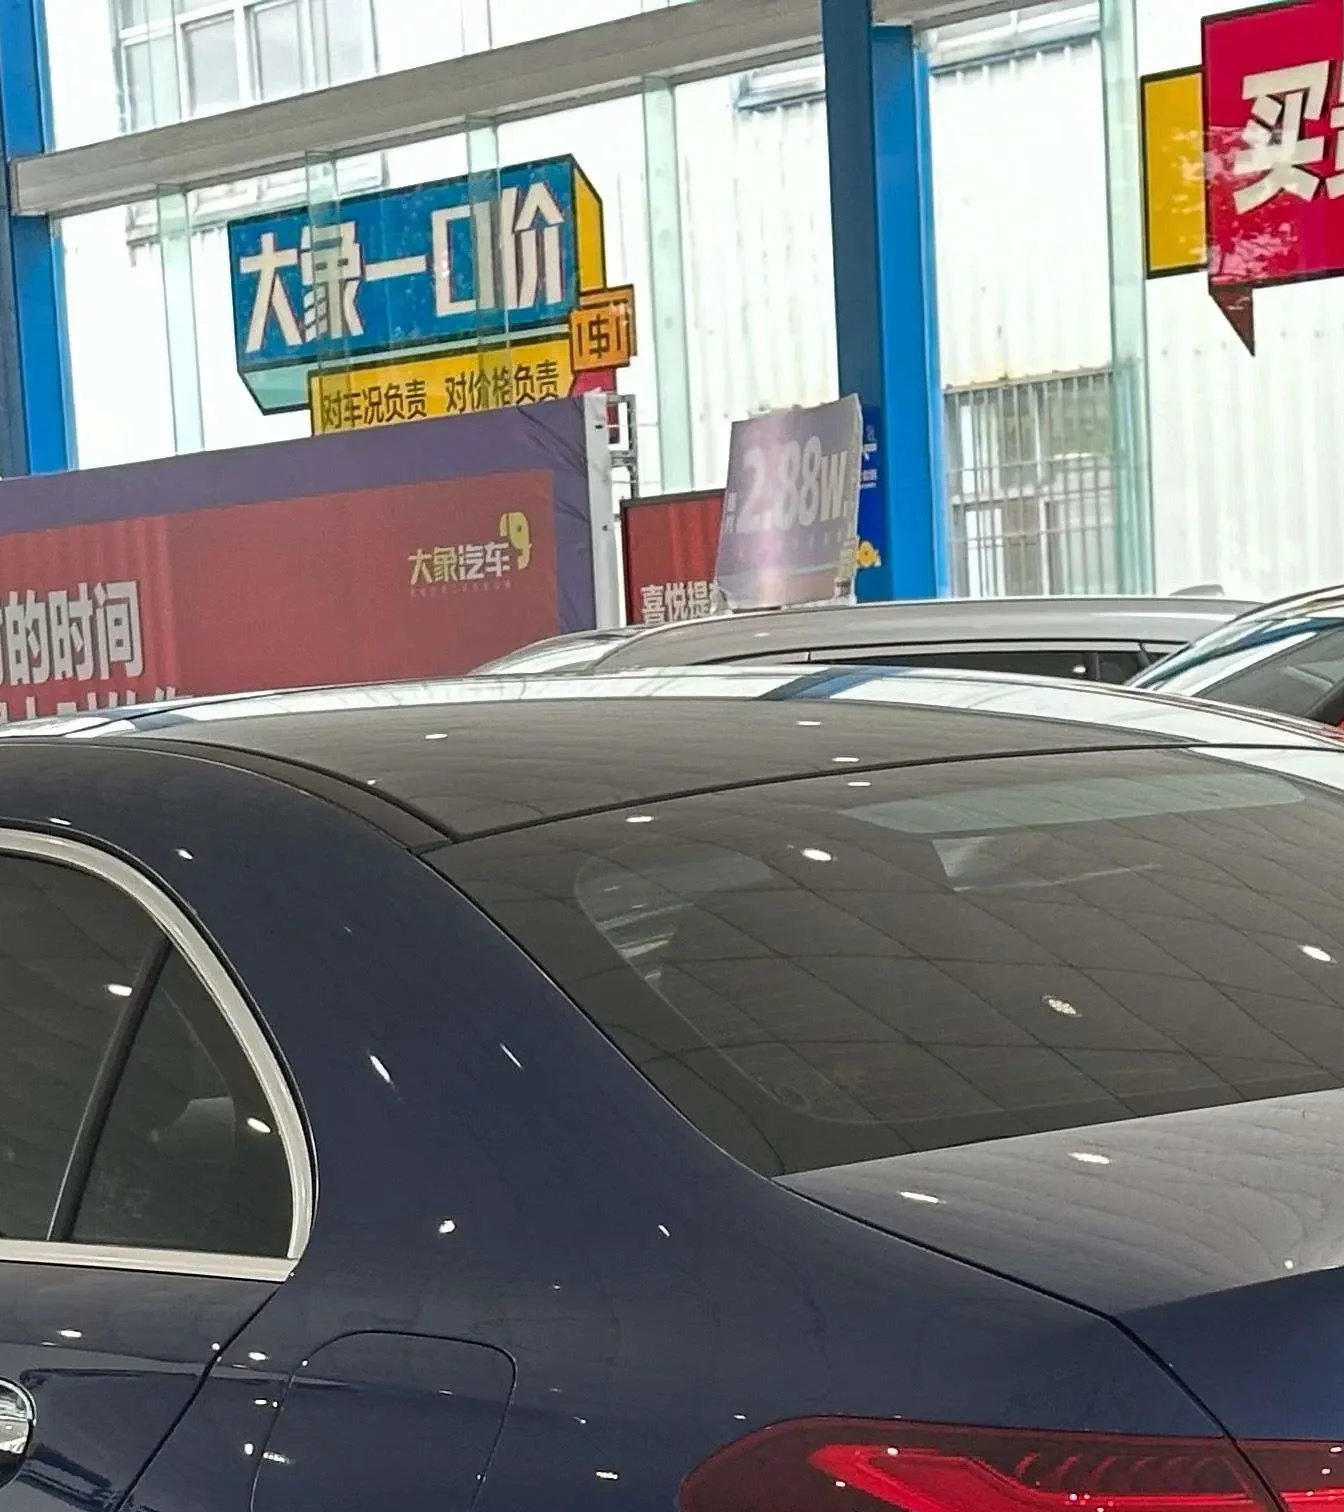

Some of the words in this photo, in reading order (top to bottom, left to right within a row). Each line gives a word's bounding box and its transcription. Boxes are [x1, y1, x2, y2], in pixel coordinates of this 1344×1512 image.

[239, 182, 565, 353] 大象一口价
[319, 379, 427, 430] 对车况负责
[445, 359, 560, 413] 对价格负责
[408, 541, 511, 585] 大象汽车
